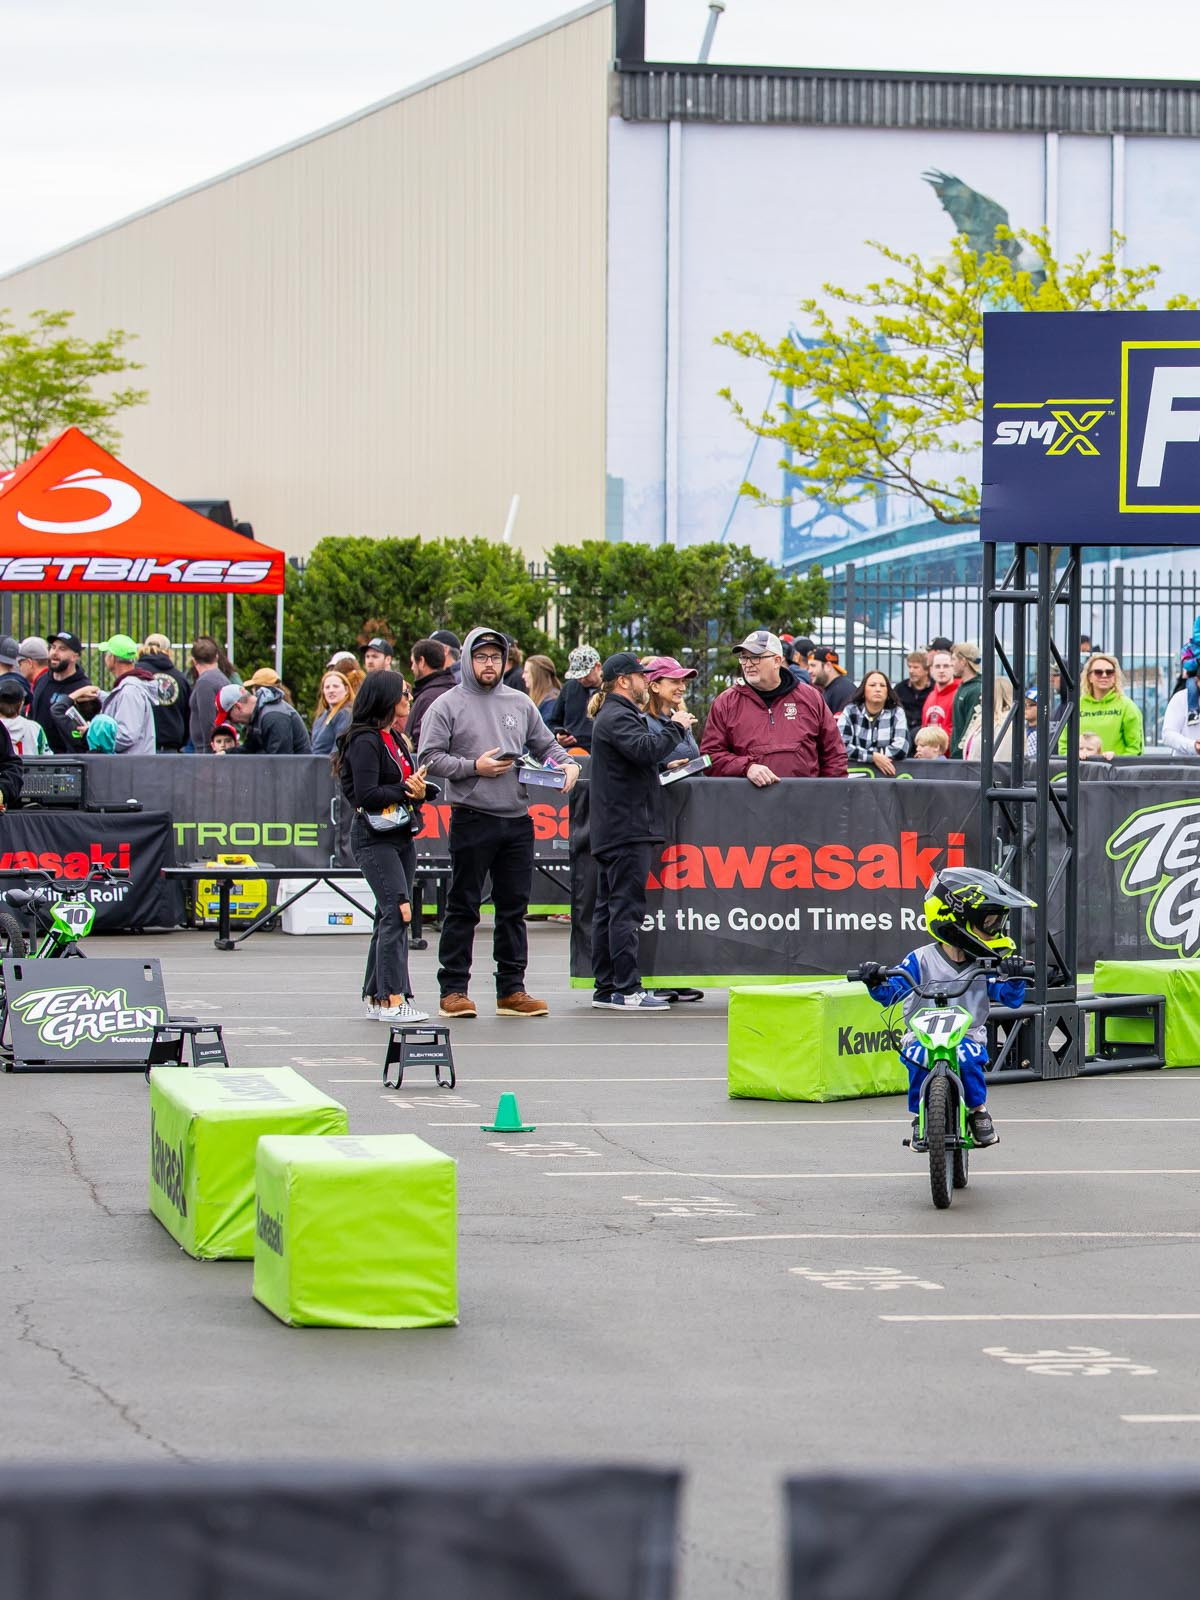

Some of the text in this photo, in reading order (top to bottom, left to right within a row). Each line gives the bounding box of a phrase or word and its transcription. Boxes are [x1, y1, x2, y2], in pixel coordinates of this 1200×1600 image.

[645, 831, 966, 891] awasaki
[62, 908, 88, 925] 10
[637, 907, 927, 932] et the Good Times Ro
[14, 987, 122, 1021] TEAM
[42, 1007, 158, 1046] GREEN
[838, 1021, 908, 1057] Kawas
[923, 1014, 957, 1034] 11
